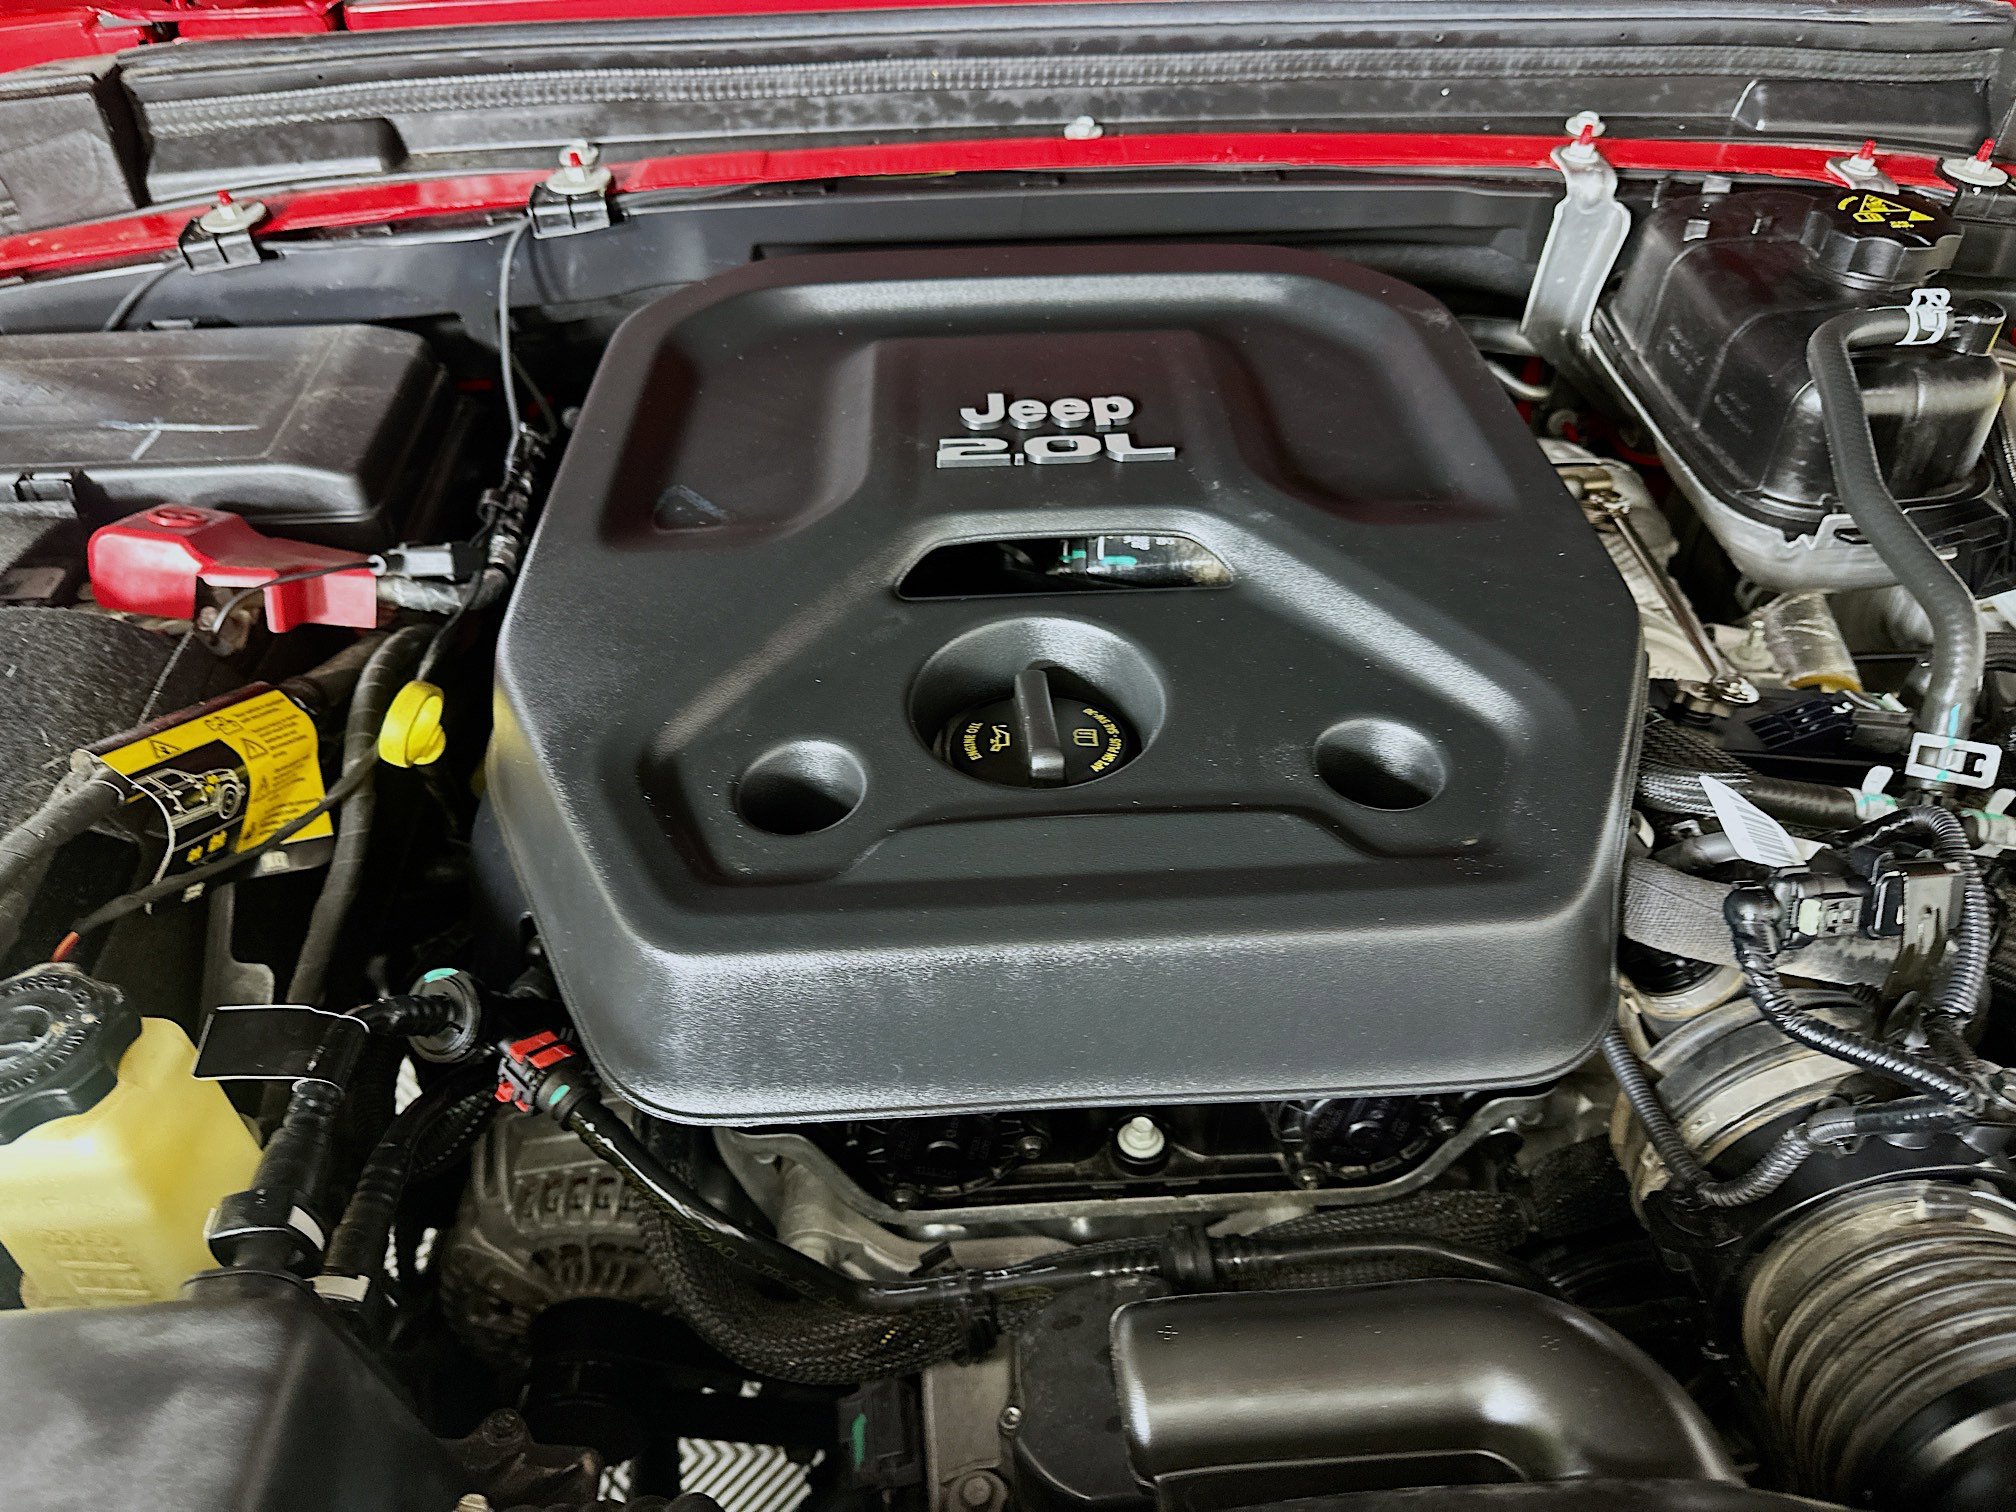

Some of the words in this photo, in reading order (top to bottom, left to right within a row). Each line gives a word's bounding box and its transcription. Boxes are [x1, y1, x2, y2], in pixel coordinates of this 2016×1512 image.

[960, 392, 1135, 432] Jeep
[936, 433, 1176, 469] 2.0L
[965, 722, 985, 734] OIL
[963, 733, 983, 761] ENGINE
[1107, 738, 1122, 754] PLUS
